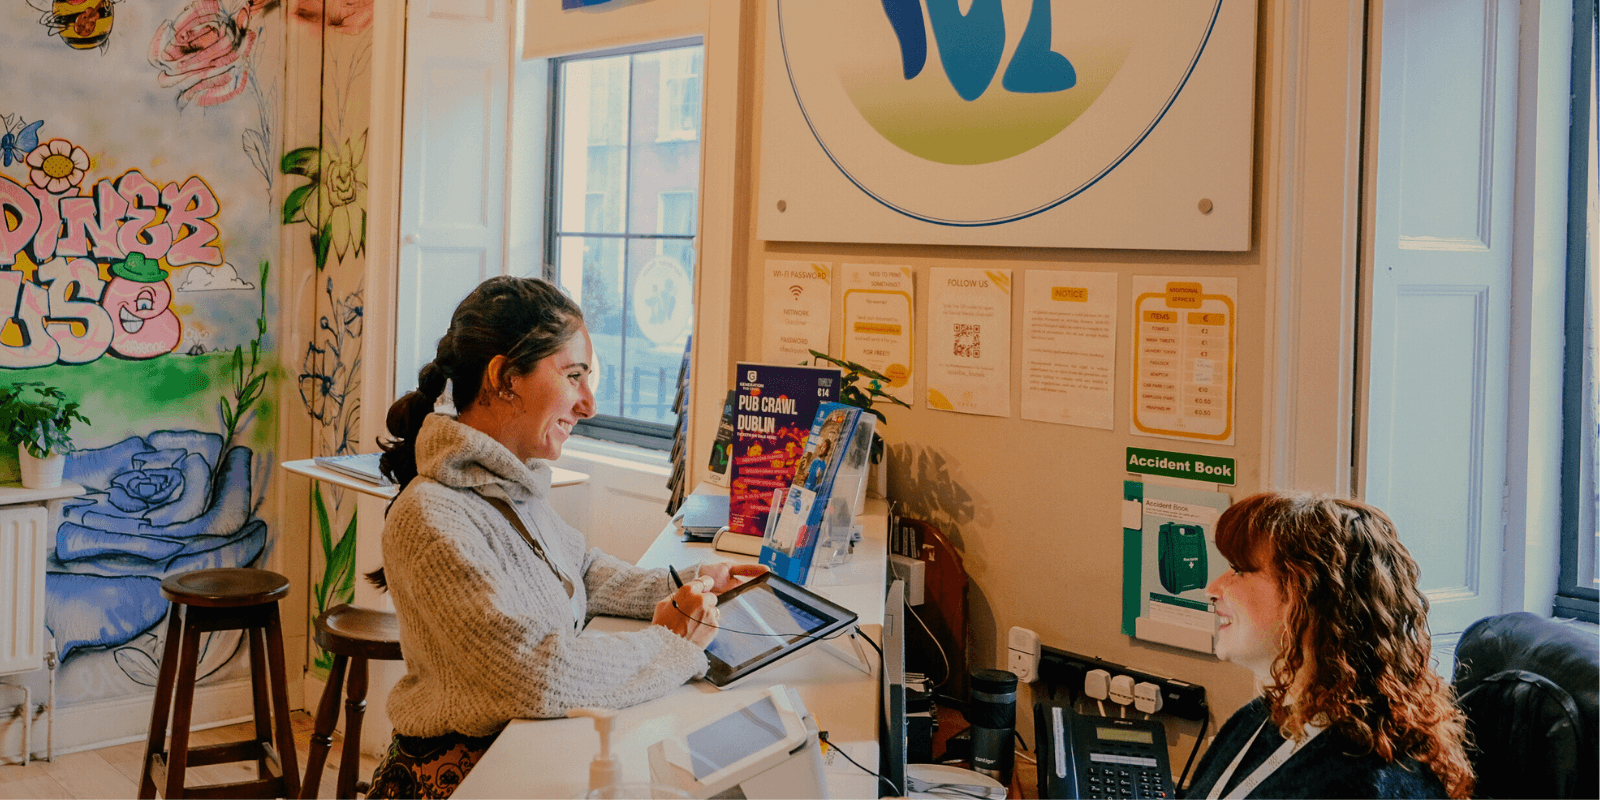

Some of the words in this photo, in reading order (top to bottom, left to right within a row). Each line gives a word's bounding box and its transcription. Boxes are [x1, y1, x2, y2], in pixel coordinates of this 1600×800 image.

[773, 270, 789, 278] WI-FI
[790, 271, 826, 280] PASSWORD
[948, 279, 977, 287] FOLLOW
[1055, 290, 1083, 298] NOTICE
[784, 309, 809, 317] NETWORK
[780, 336, 808, 345] PASSWORD
[739, 395, 760, 411] PUB
[761, 396, 798, 415] CRAWL
[737, 414, 776, 434] DUBLIN
[1129, 454, 1191, 472] Accident
[1195, 461, 1231, 476] Book
[1146, 500, 1171, 510] Accident
[1173, 503, 1189, 512] Book
